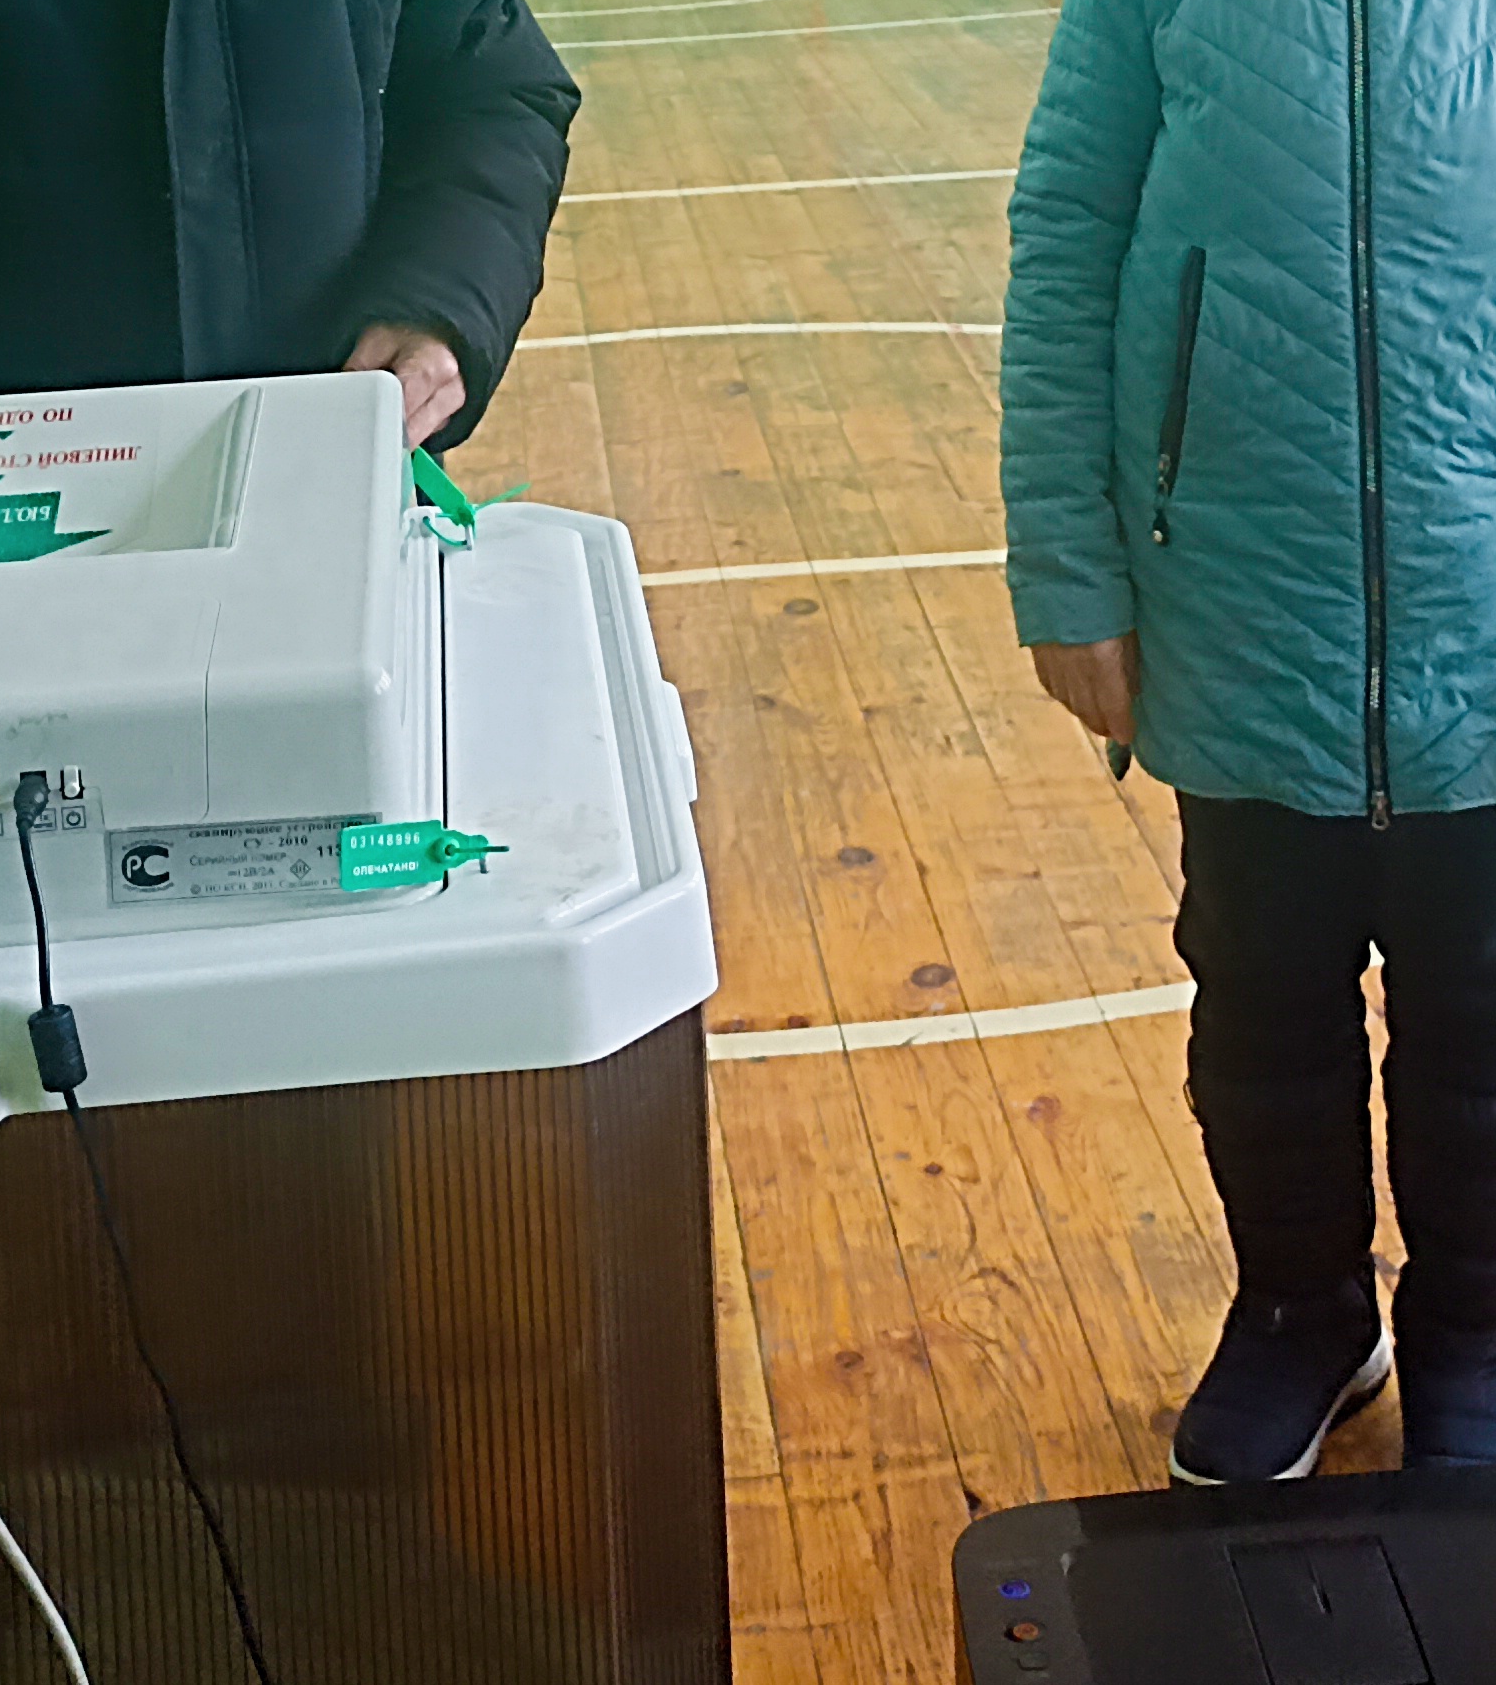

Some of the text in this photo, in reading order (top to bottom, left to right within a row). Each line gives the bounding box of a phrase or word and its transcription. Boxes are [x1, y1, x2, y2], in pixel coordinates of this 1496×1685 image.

[43, 407, 73, 423] ПО
[38, 446, 141, 470] ЛИЦЕВОЙ
[279, 834, 308, 848] 2010
